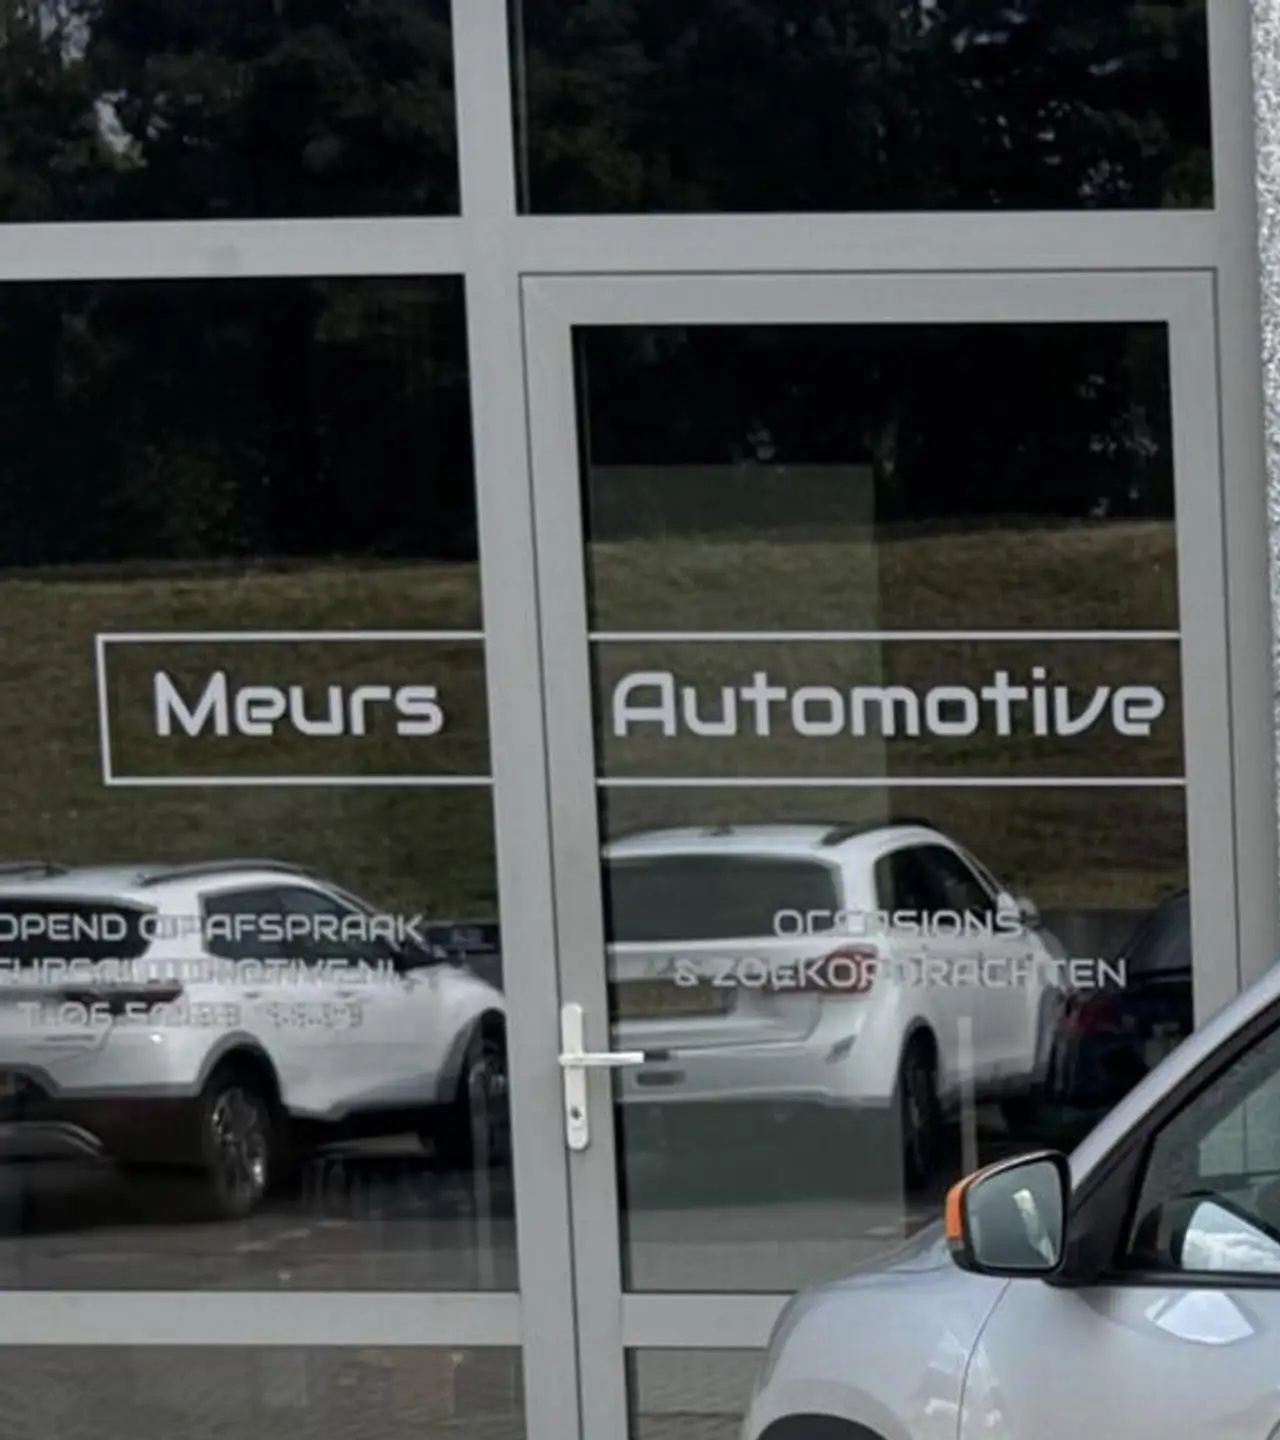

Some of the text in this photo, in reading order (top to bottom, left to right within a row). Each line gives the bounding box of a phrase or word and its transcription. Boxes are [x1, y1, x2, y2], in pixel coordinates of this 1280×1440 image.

[153, 667, 1165, 737] Meurs Automotive
[205, 913, 425, 942] AFSPRAAK
[773, 909, 1024, 938] OCCASIONS
[712, 956, 1127, 988] ZOEKOPDRACHTEN
